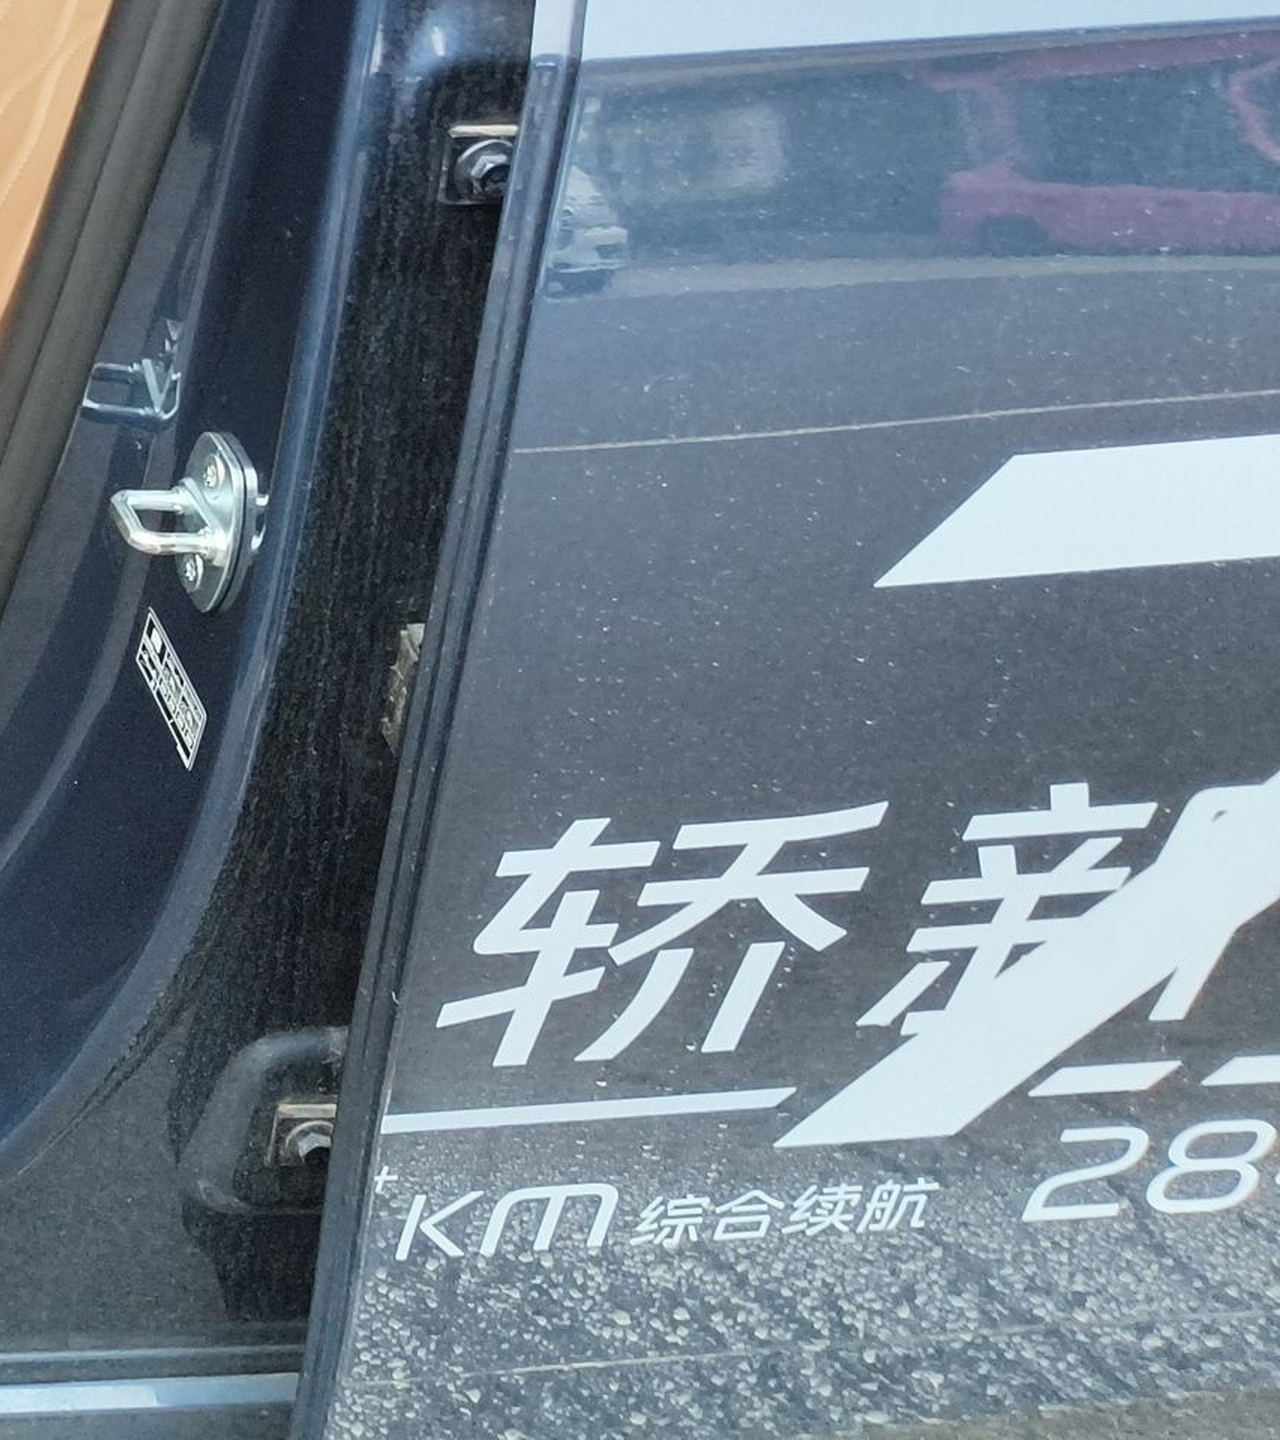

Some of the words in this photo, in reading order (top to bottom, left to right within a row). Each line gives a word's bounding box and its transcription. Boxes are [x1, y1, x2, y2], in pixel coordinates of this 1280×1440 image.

[630, 1177, 941, 1247] 综合续航
[1021, 1118, 1280, 1223] 28
